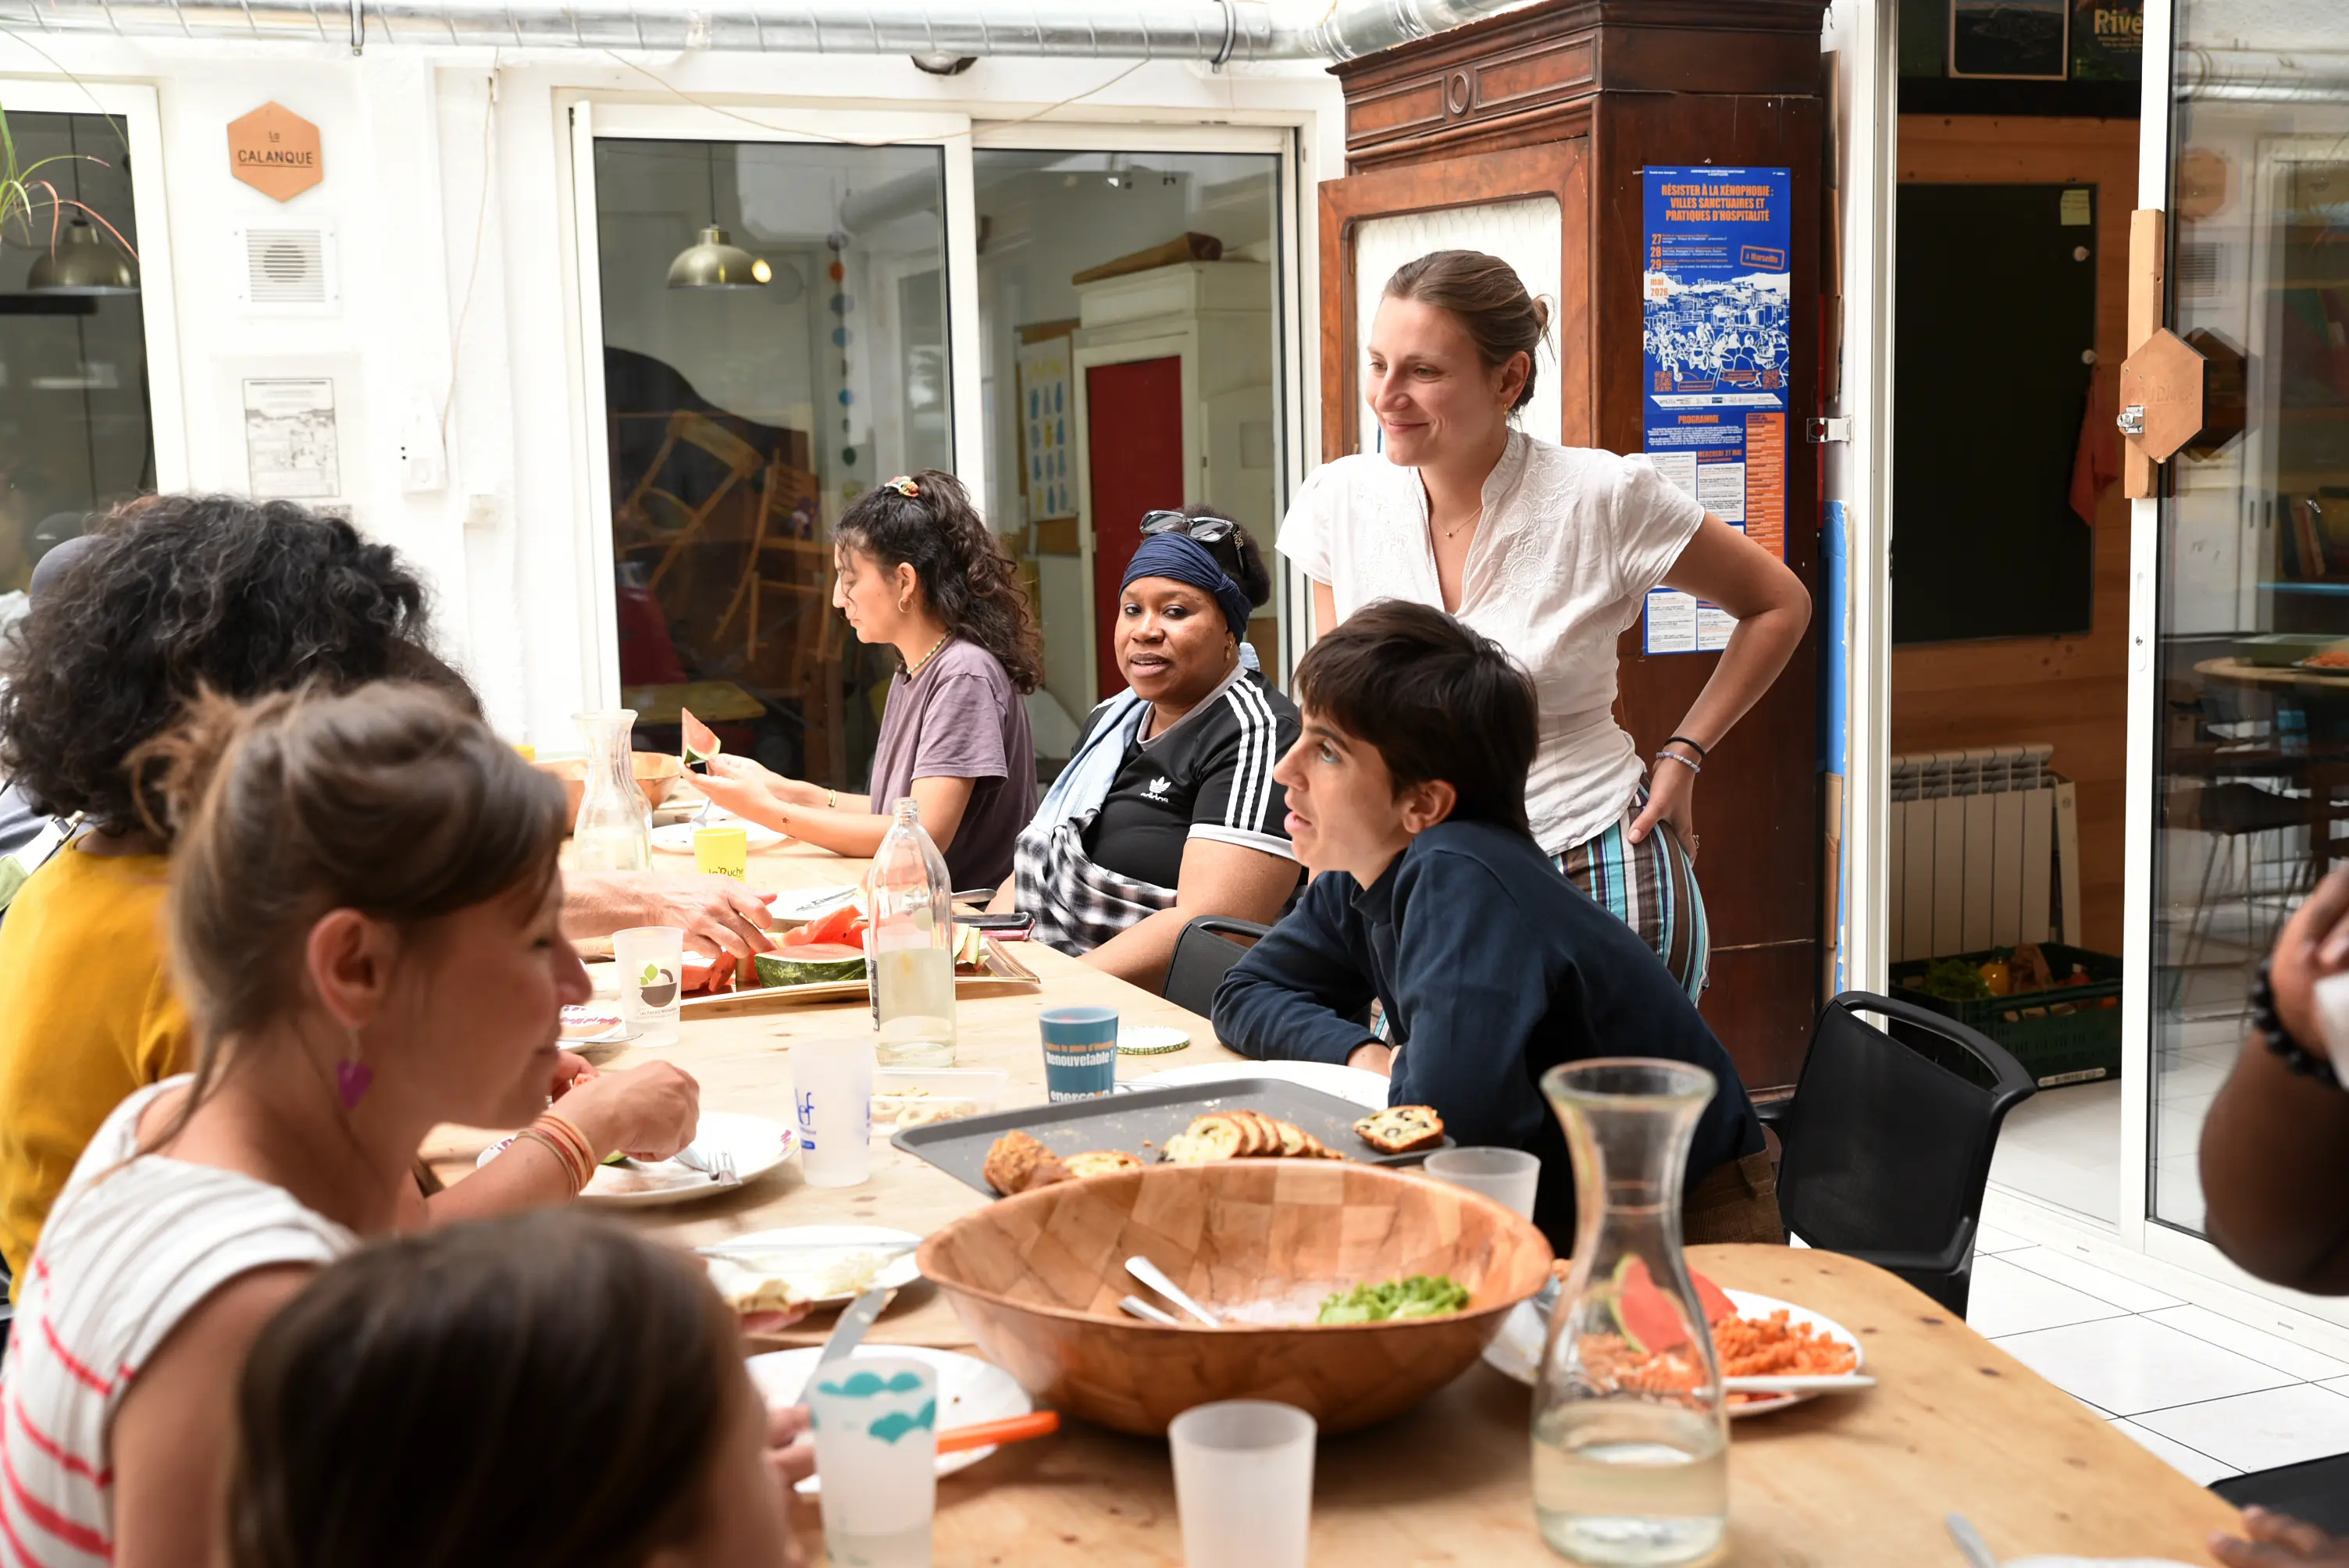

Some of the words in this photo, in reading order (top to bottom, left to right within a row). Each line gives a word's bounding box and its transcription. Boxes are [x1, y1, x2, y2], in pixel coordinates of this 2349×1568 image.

[237, 149, 313, 165] CALANQUE
[1661, 183, 1701, 196] RÉSISTER
[1702, 183, 1708, 196] À
[1709, 184, 1719, 196] LA
[1720, 183, 1770, 197] XÉNOPHOBIE
[1670, 197, 1698, 208] VILLES
[1698, 197, 1755, 208] SANCTUAIRES
[1756, 198, 1765, 208] ET
[1666, 210, 1711, 222] PRATIQUES
[1712, 208, 1770, 222] D'HOSPITALITÉ
[1652, 233, 1662, 244] 27
[1650, 246, 1662, 258] 28
[1650, 258, 1662, 270] 29
[1678, 415, 1720, 424] PROGRAMME
